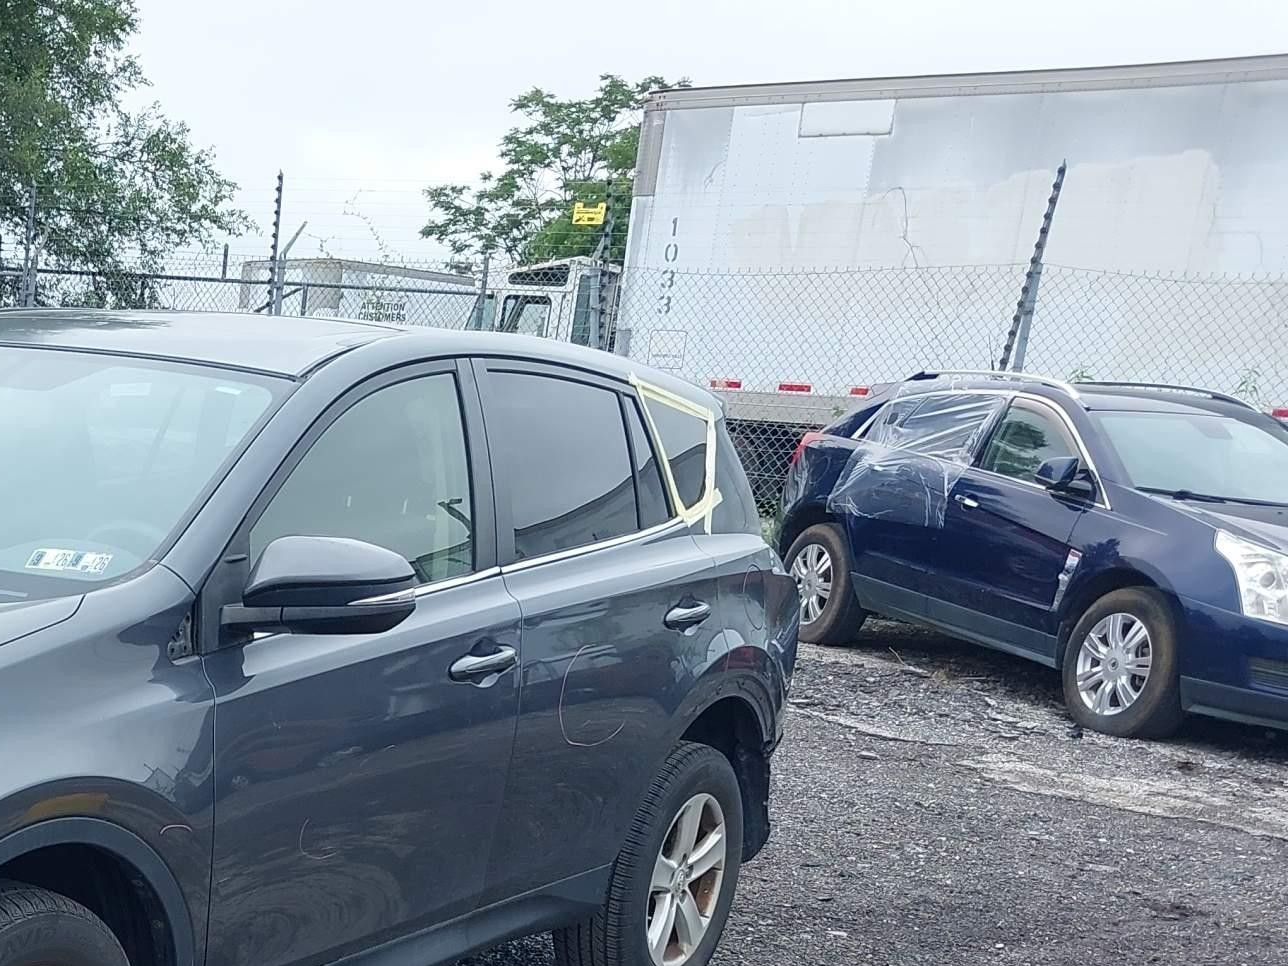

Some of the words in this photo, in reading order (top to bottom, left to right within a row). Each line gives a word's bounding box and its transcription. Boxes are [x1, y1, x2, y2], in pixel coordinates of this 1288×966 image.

[657, 216, 679, 315] 1033
[361, 302, 406, 311] ATTENTION
[358, 311, 406, 321] CUSTOMERS
